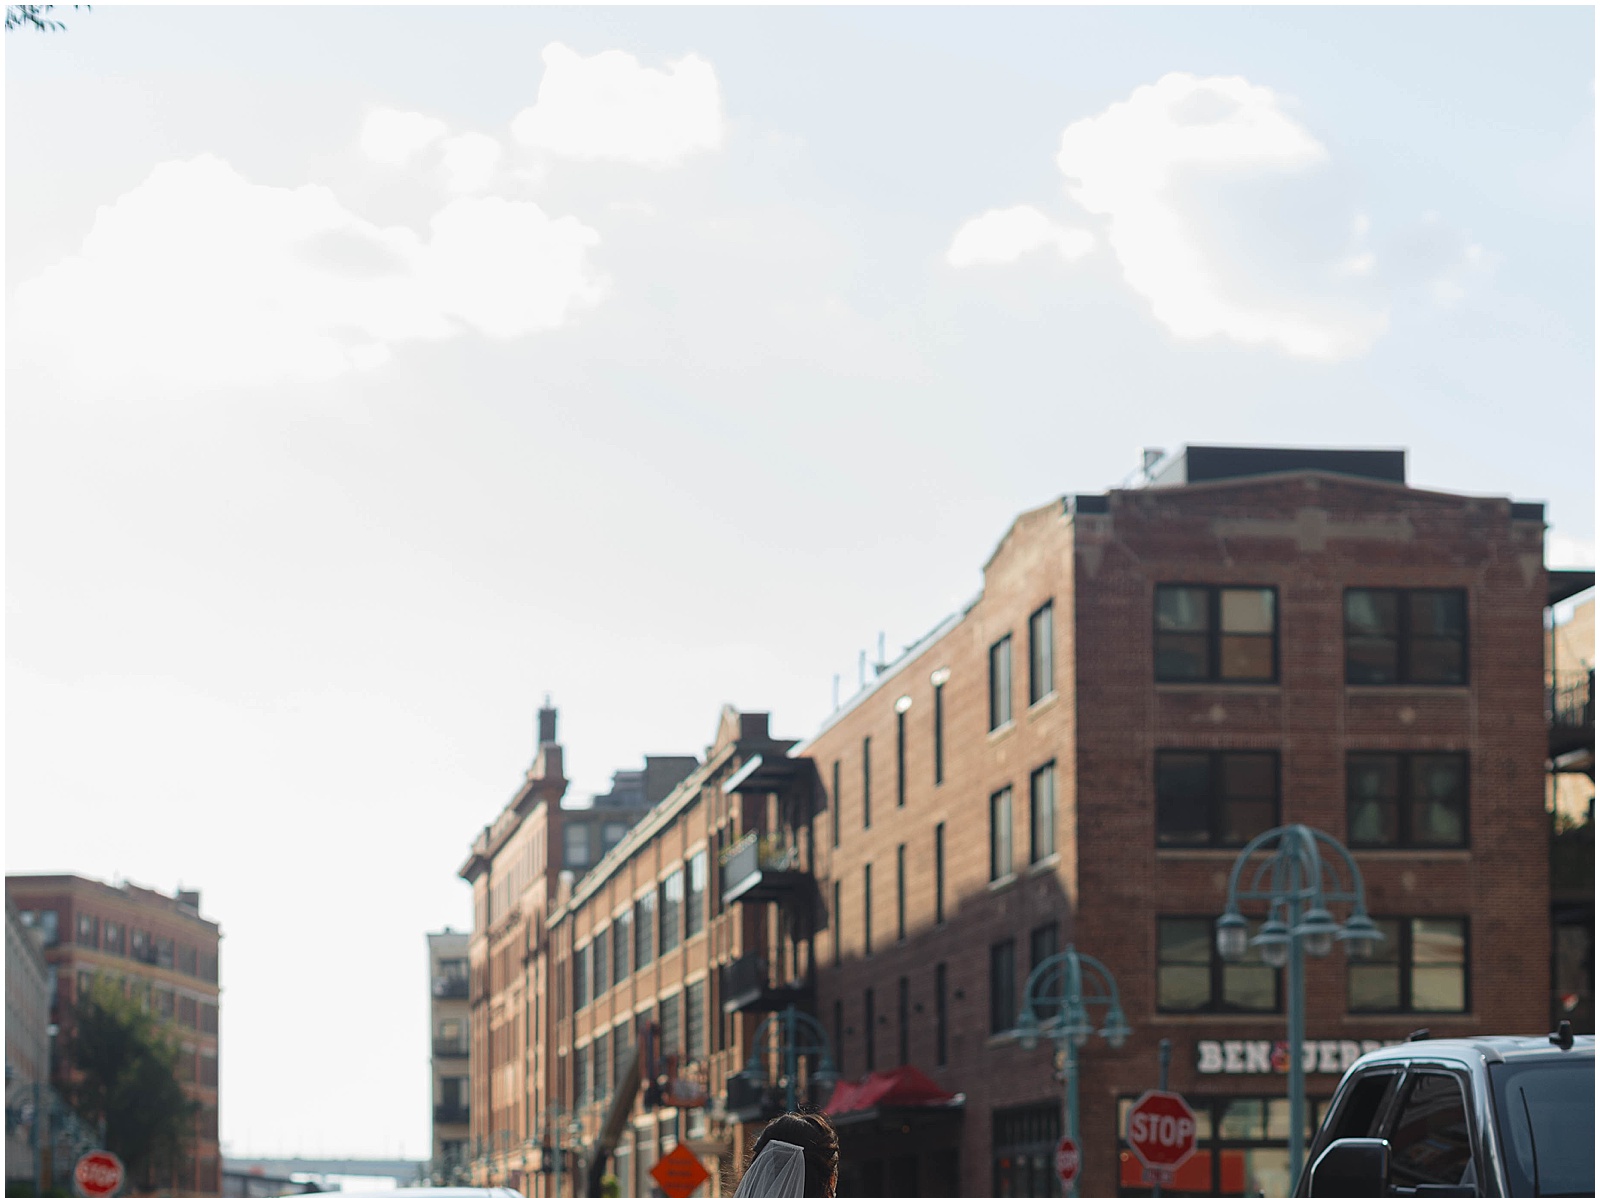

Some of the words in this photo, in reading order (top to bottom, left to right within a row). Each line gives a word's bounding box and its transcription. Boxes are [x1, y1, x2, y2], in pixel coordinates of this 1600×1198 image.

[1197, 1040, 1271, 1072] BEN
[1132, 1112, 1194, 1148] STOP
[79, 1161, 119, 1187] STOP
